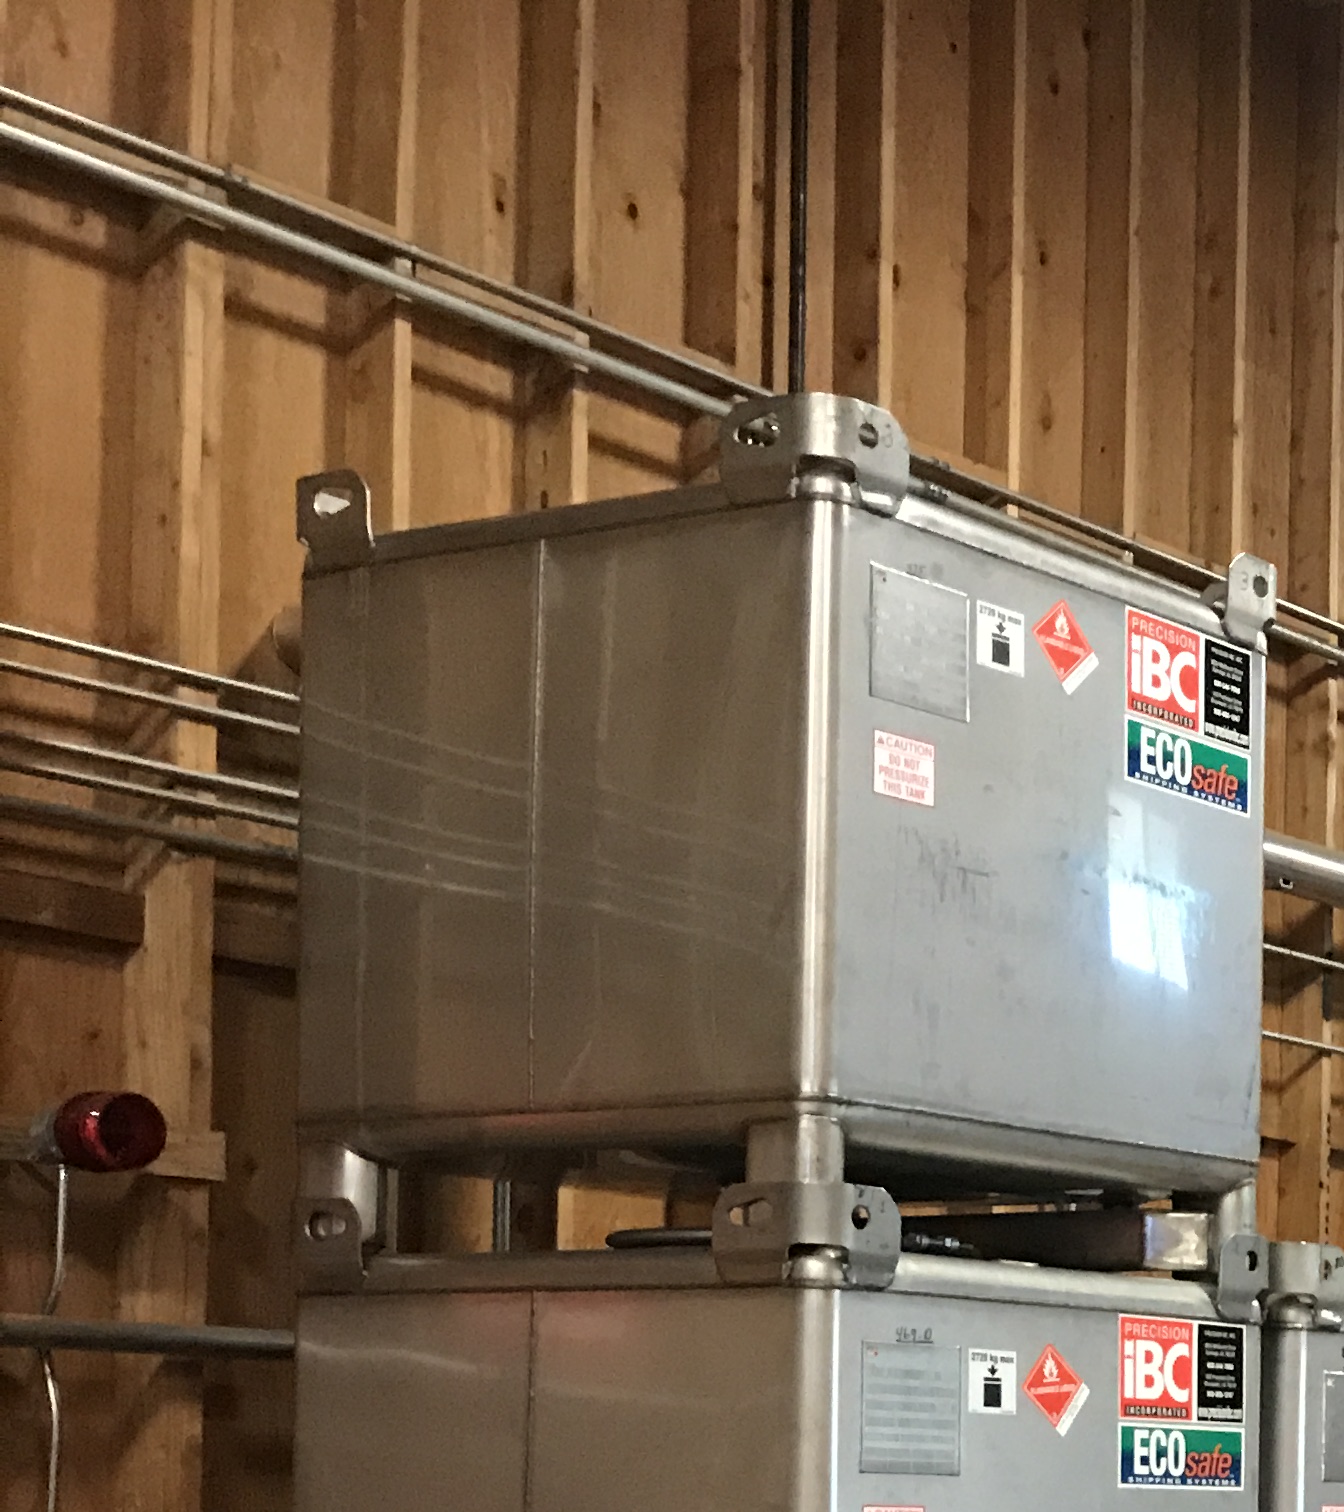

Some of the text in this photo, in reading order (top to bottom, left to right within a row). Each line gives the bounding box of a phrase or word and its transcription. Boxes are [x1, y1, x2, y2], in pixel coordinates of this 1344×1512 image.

[1131, 616, 1196, 651] PRECISION
[1133, 699, 1194, 728] INCORPORATED
[886, 736, 933, 758] CAUTION
[888, 753, 920, 771] DO NOT
[883, 779, 902, 795] THIS
[1124, 1322, 1190, 1340] PRECISION
[1126, 1405, 1188, 1418] INCORPORATED
[1127, 1476, 1182, 1485] SHIPPING
